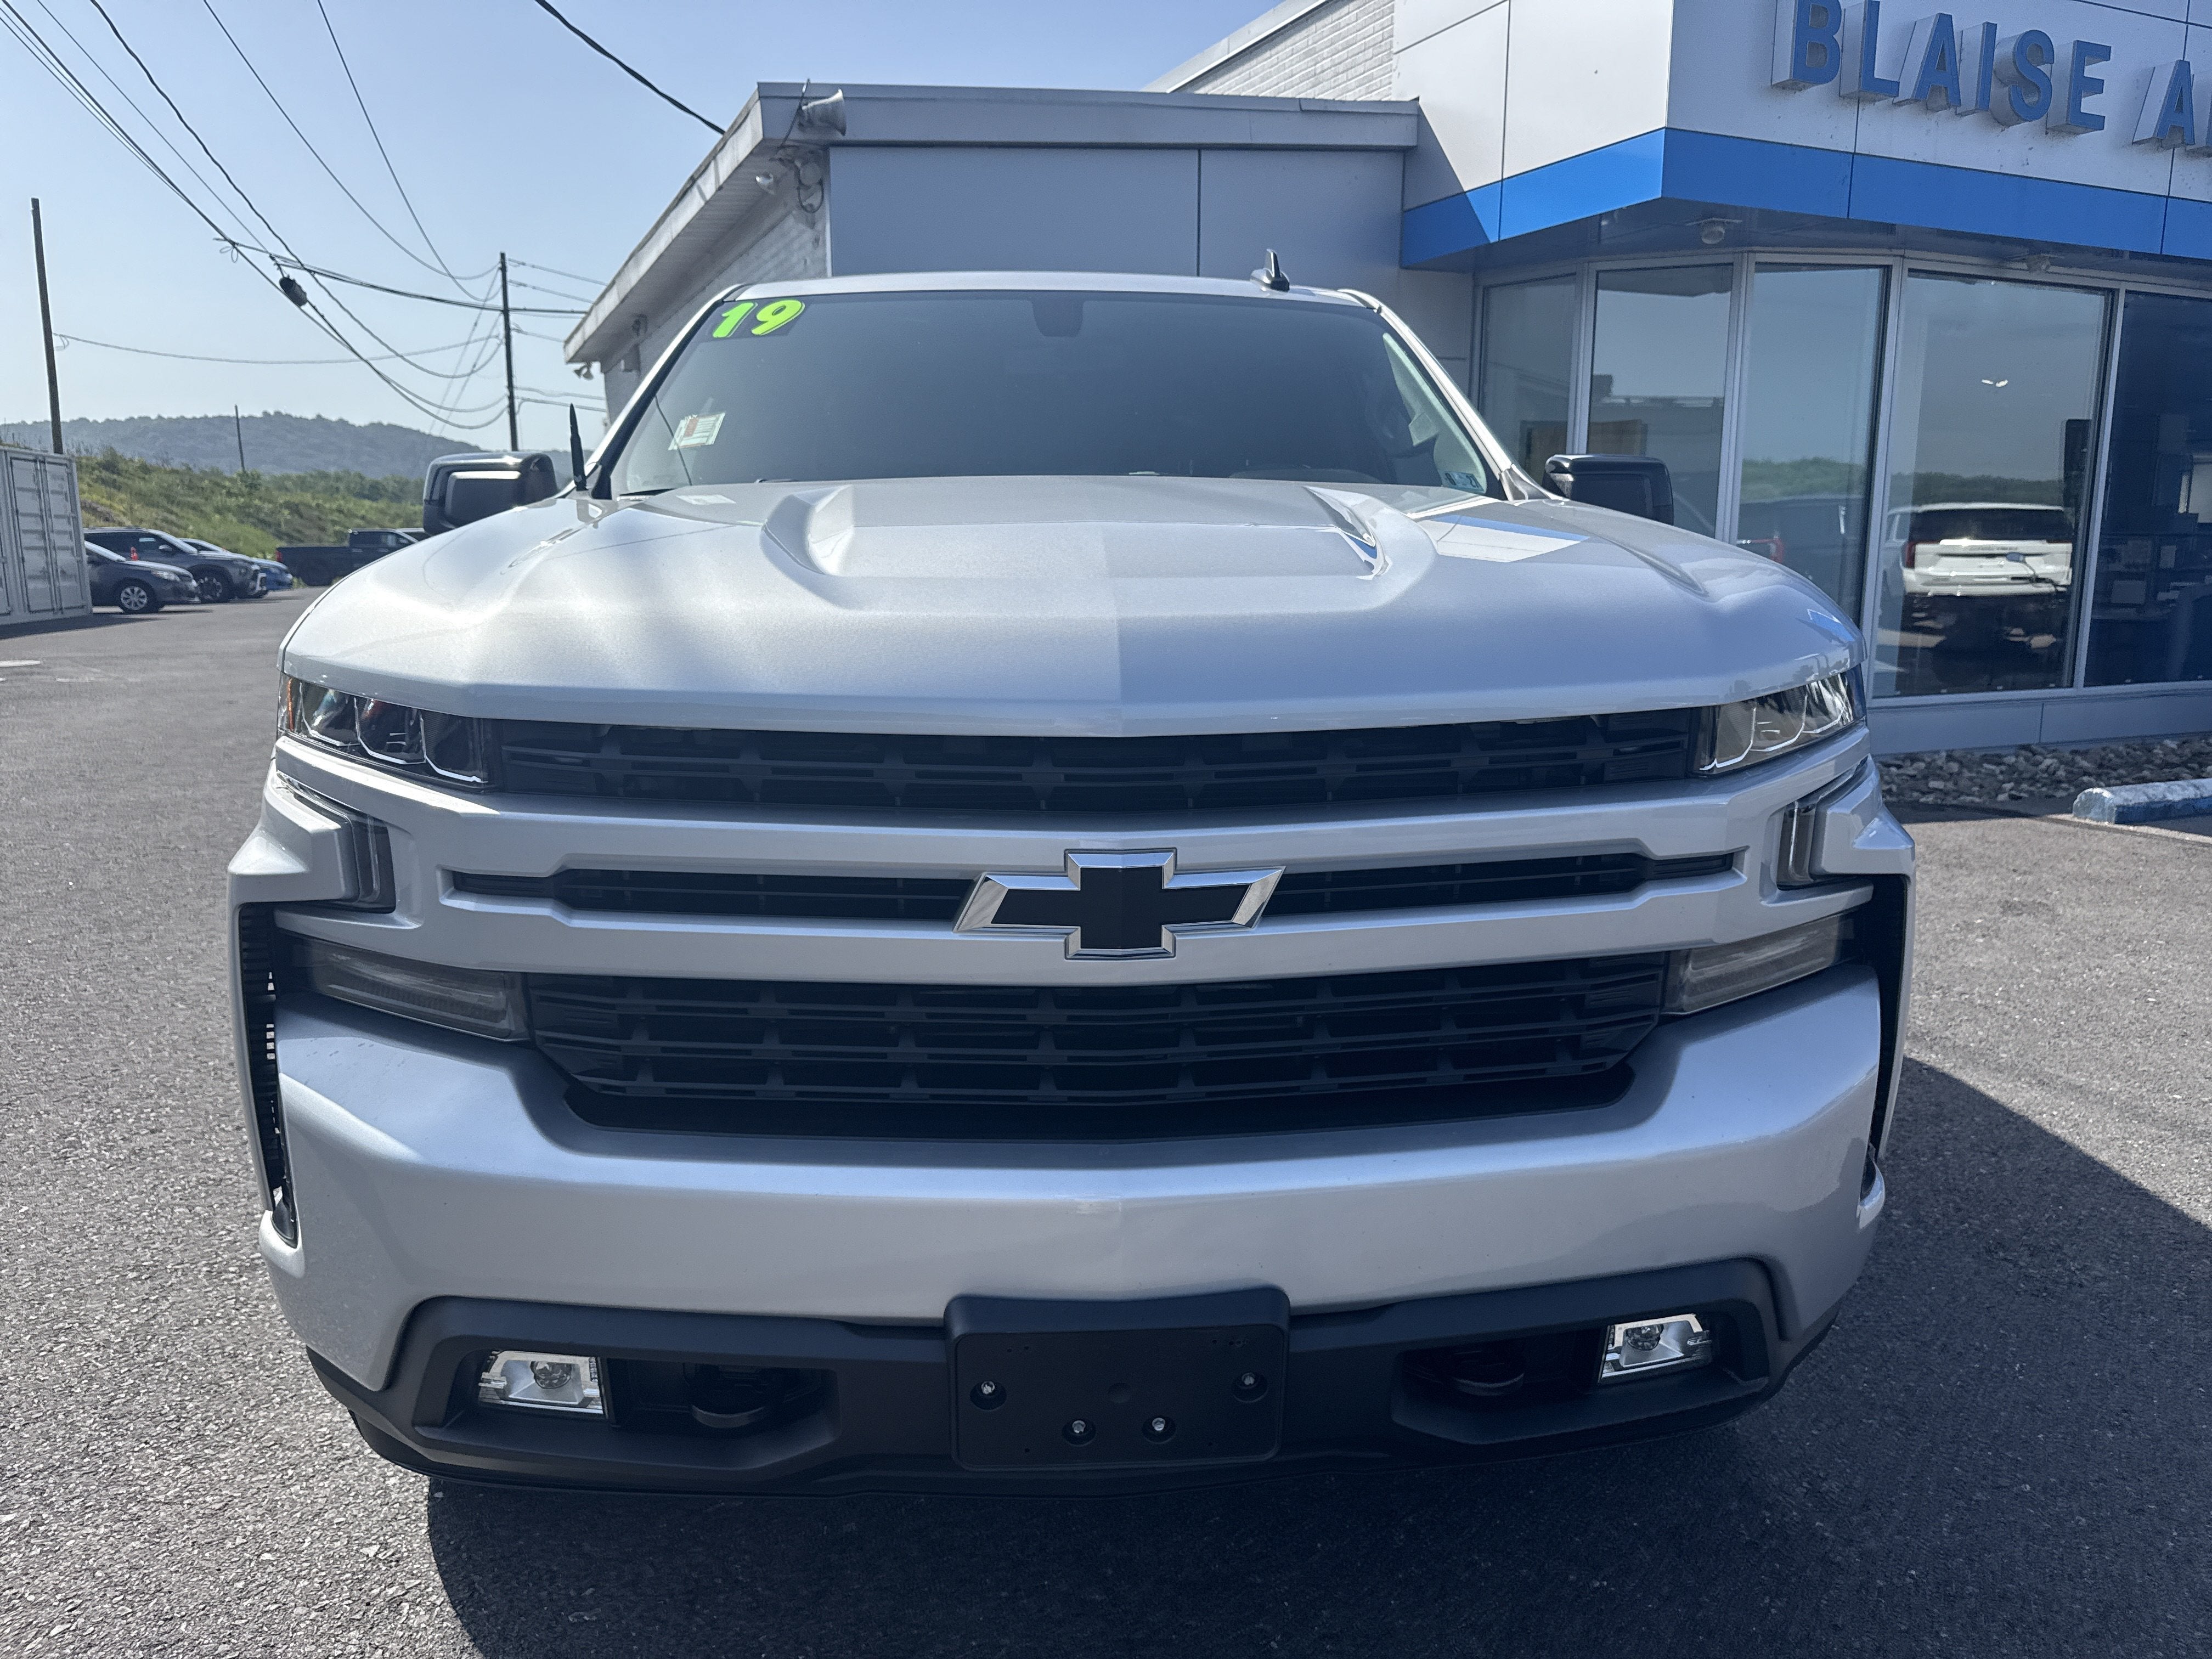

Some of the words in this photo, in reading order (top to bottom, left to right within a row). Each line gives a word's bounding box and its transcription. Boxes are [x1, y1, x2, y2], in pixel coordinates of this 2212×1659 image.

[1787, 0, 2111, 132] BLAISE
[2153, 59, 2212, 147] A
[713, 300, 805, 338] 19
